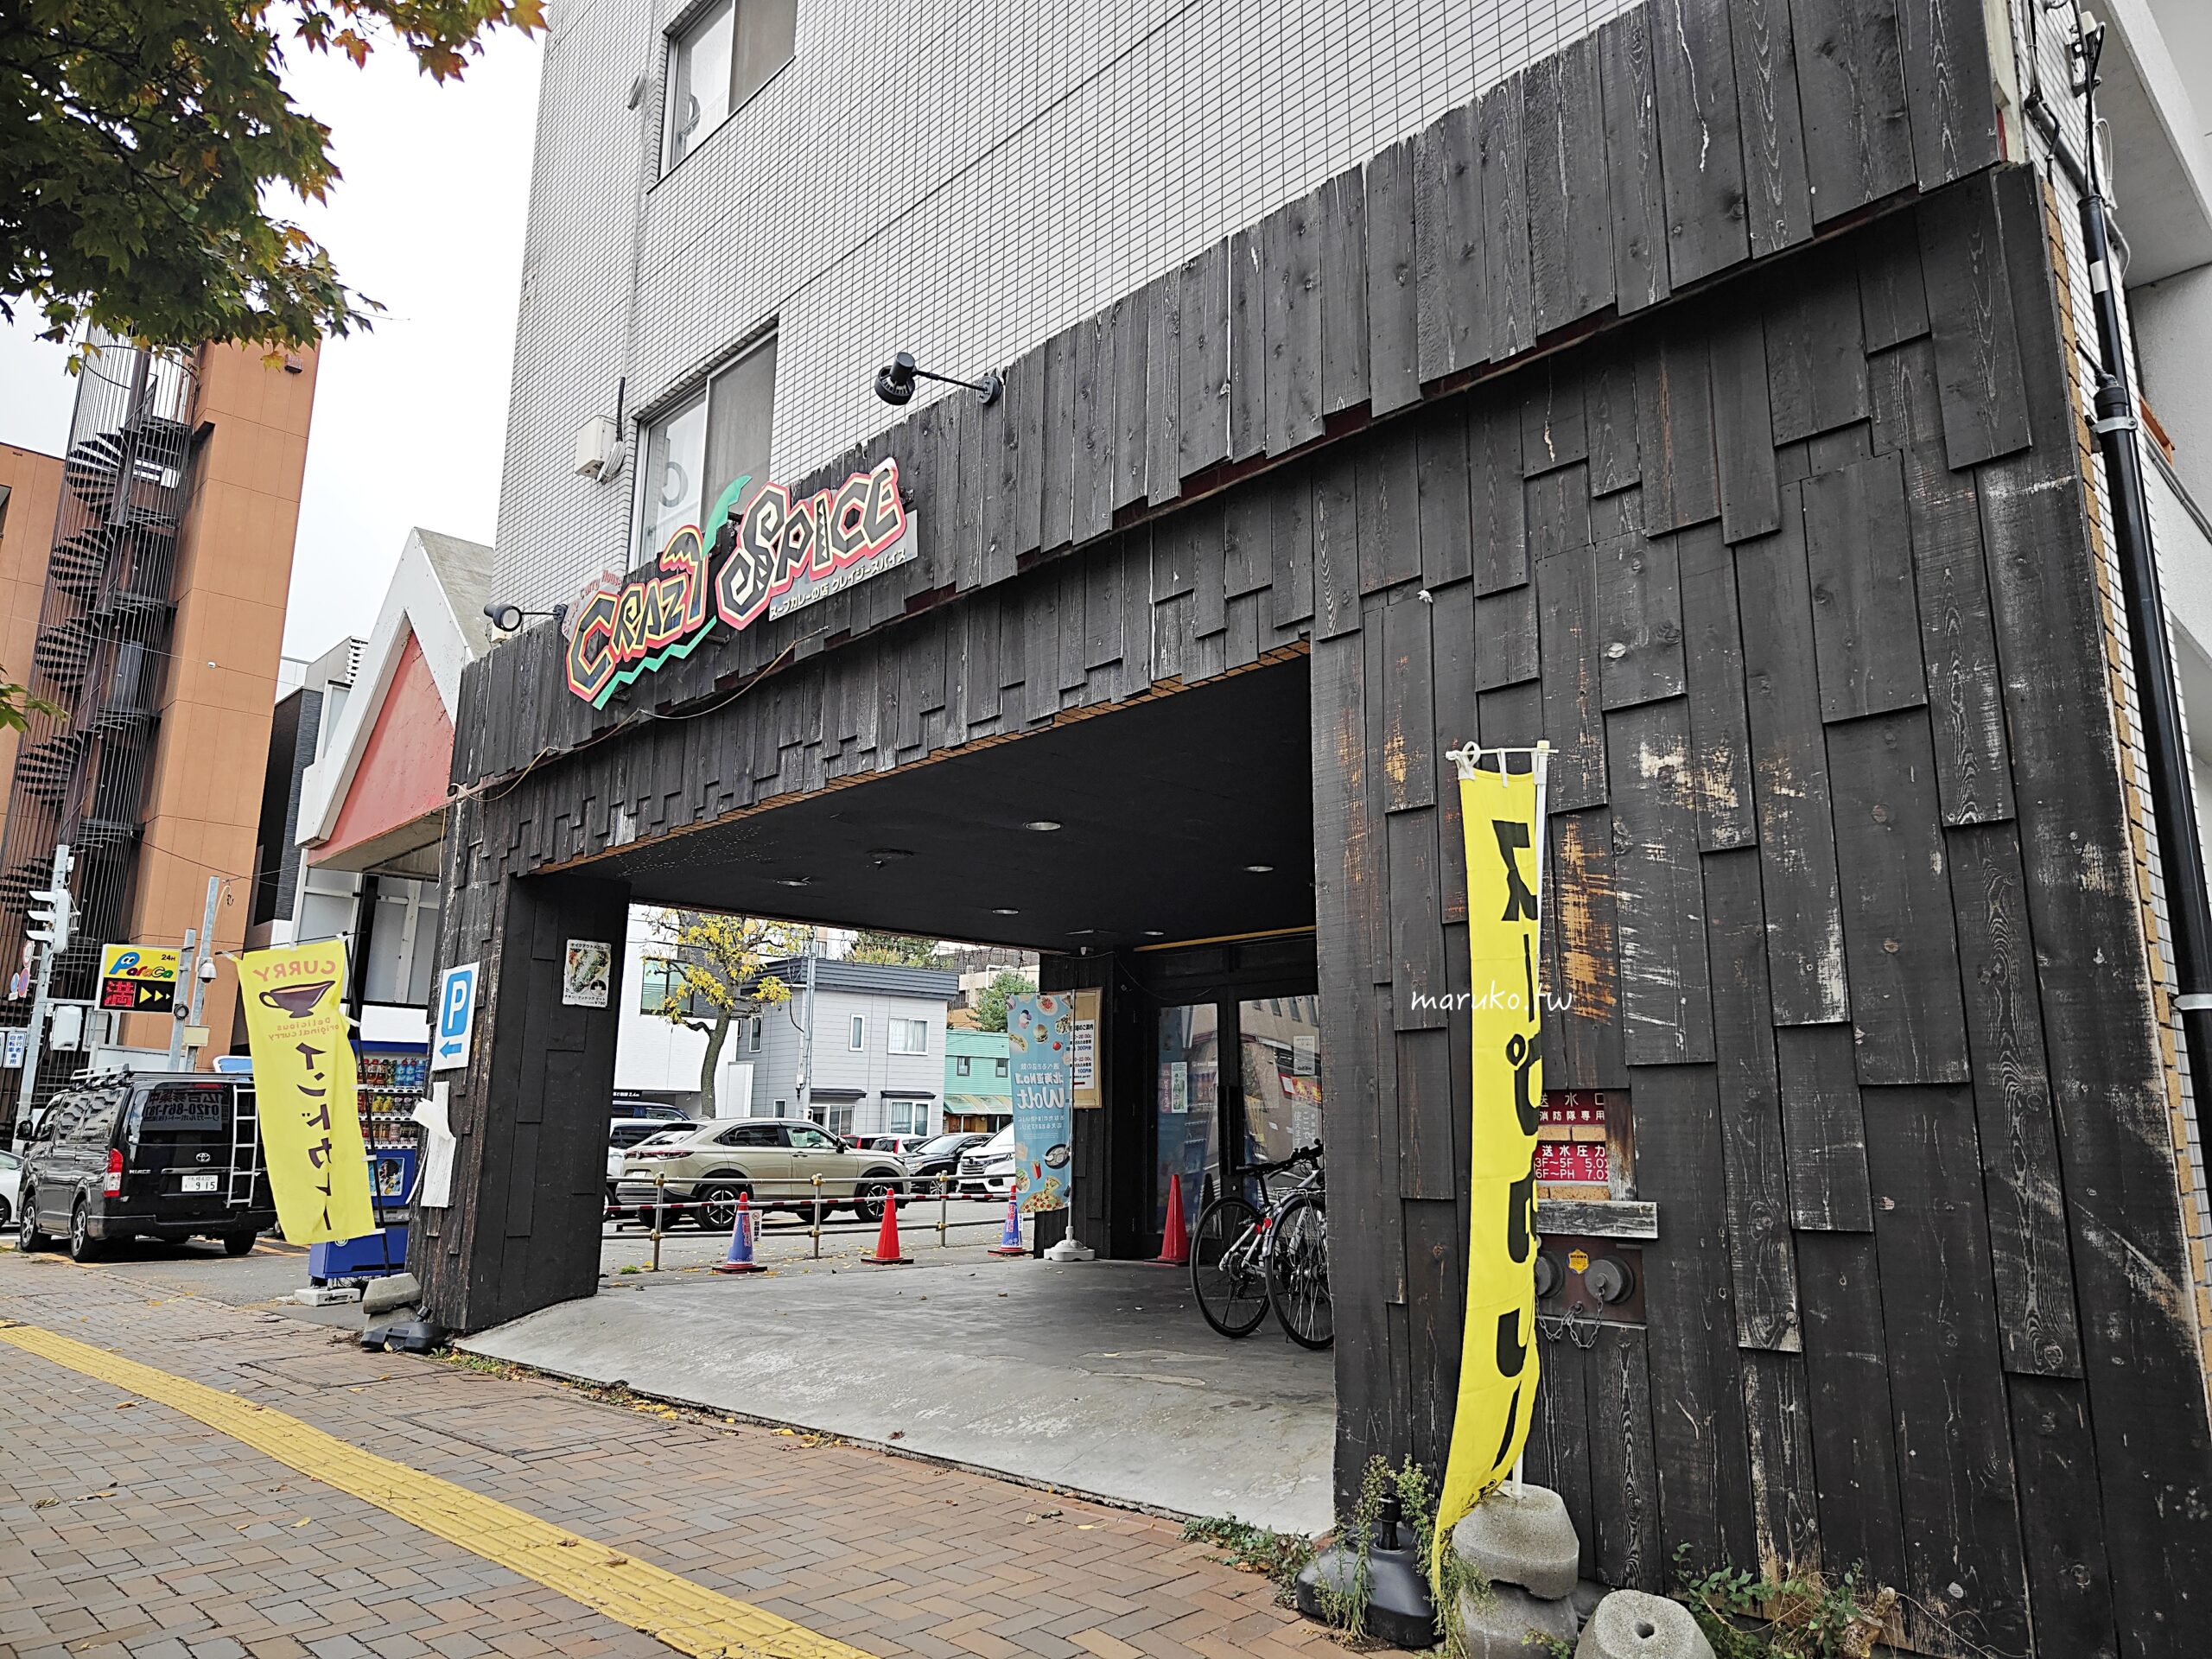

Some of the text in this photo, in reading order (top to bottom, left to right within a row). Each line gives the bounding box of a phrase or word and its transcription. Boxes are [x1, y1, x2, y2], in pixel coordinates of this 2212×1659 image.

[716, 463, 906, 628] SPICE
[770, 548, 907, 617] スープカレーの店 クレイジースパイス
[448, 980, 467, 1029] P
[1539, 1110, 1605, 1121] 消防隊専用
[1541, 1144, 1605, 1158] 送水圧力
